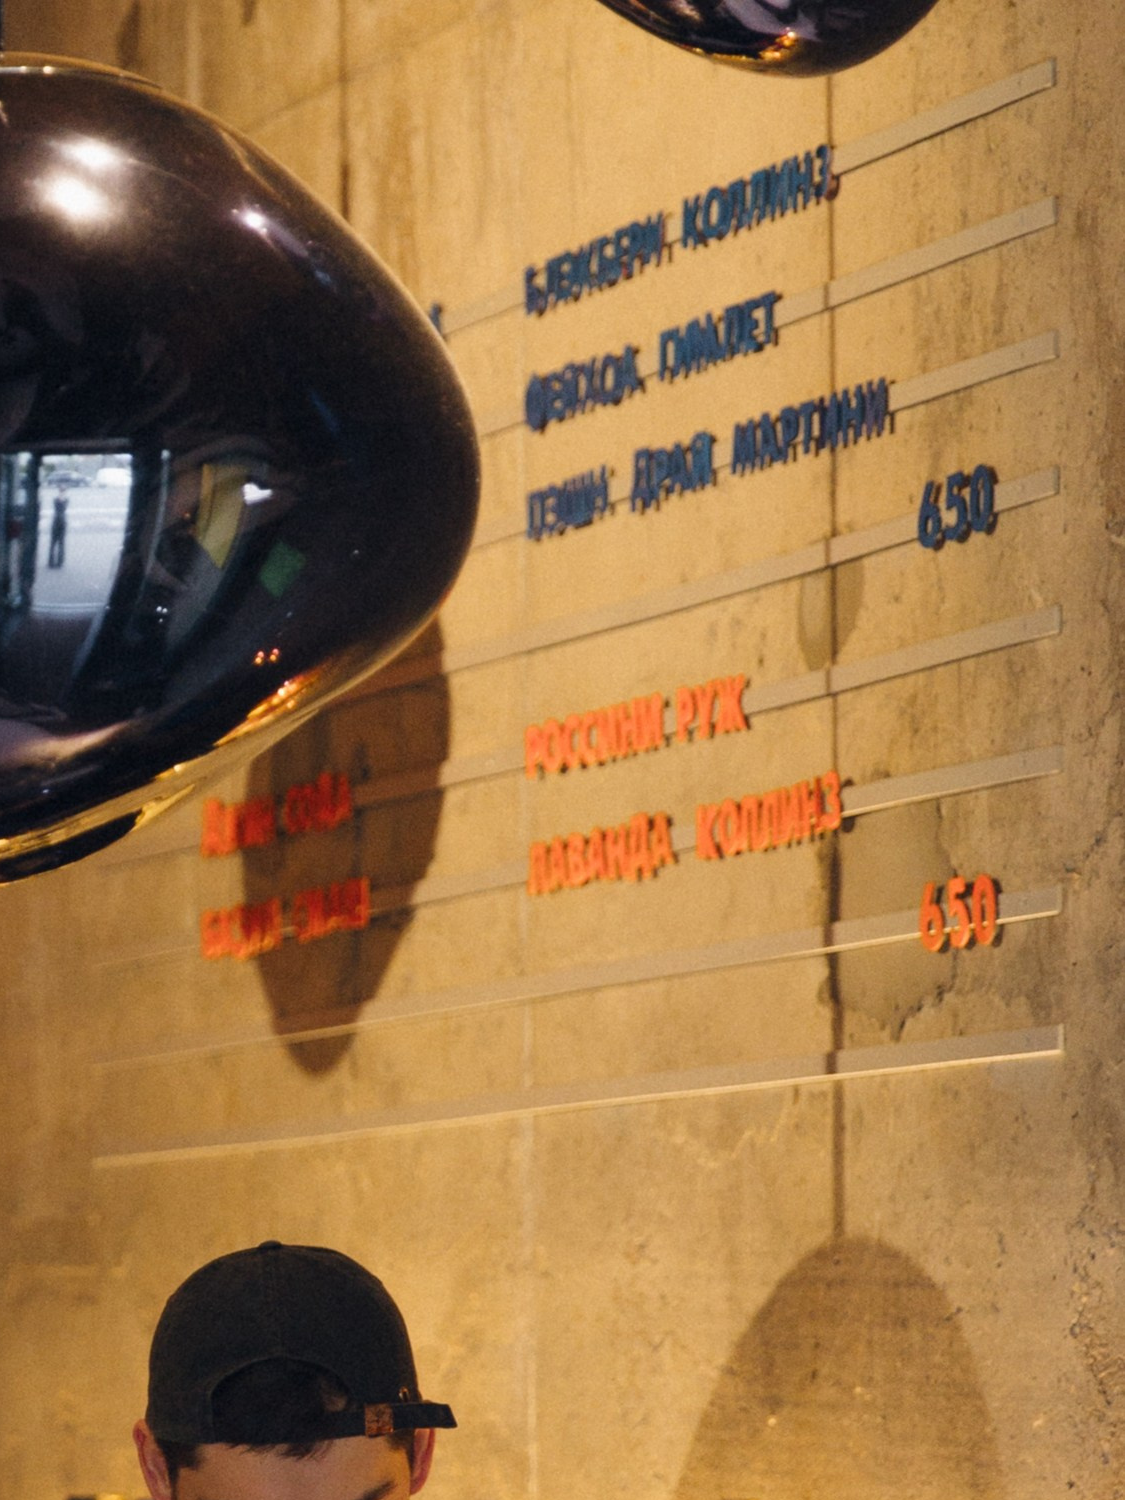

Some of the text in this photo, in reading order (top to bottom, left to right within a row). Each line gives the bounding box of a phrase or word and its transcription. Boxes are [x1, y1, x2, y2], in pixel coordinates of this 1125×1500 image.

[681, 144, 832, 250] КОЛЛИНЗ
[732, 377, 890, 475] МАРТИНИ
[918, 464, 995, 549] 650
[525, 674, 748, 779] РОССИНИ РУЖ
[528, 770, 841, 896] ЛАВАНДА КОЛЛИНЗ
[919, 873, 996, 952] 650
